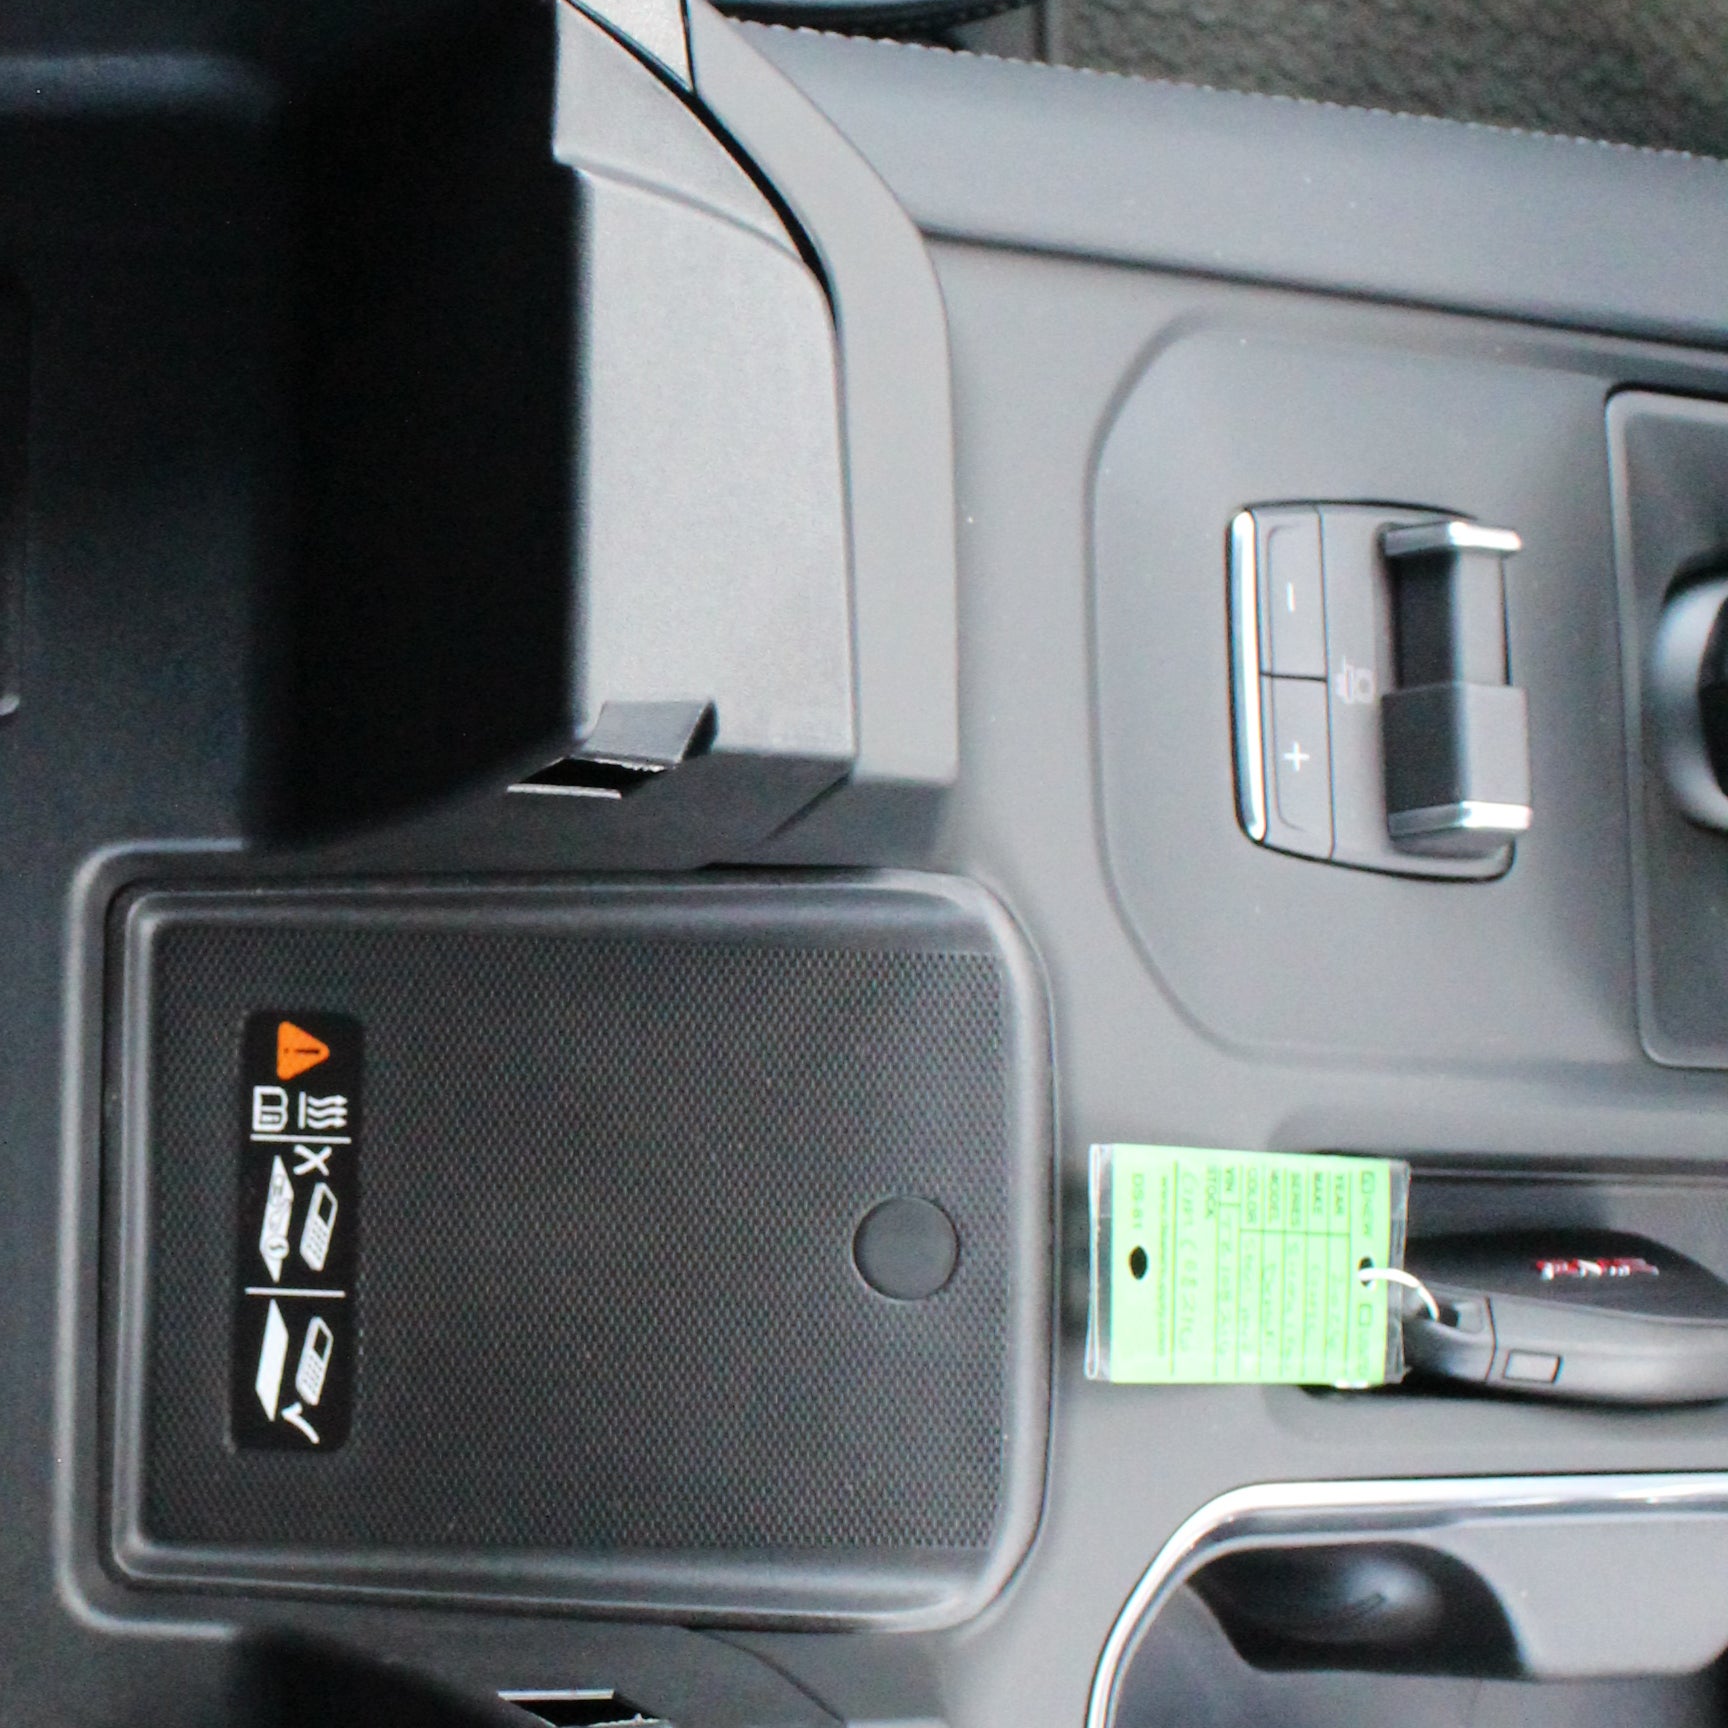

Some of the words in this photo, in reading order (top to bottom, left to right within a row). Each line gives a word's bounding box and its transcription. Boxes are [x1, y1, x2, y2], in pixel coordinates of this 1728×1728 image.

[1205, 1166, 1217, 1219] STOCK
[1225, 1167, 1234, 1191] VIN
[1246, 1167, 1257, 1224] COLOR
[1268, 1170, 1279, 1223] MODEL
[1291, 1172, 1301, 1227] SERIES
[1313, 1171, 1323, 1214] MAKE
[1334, 1173, 1344, 1216] YEAR
